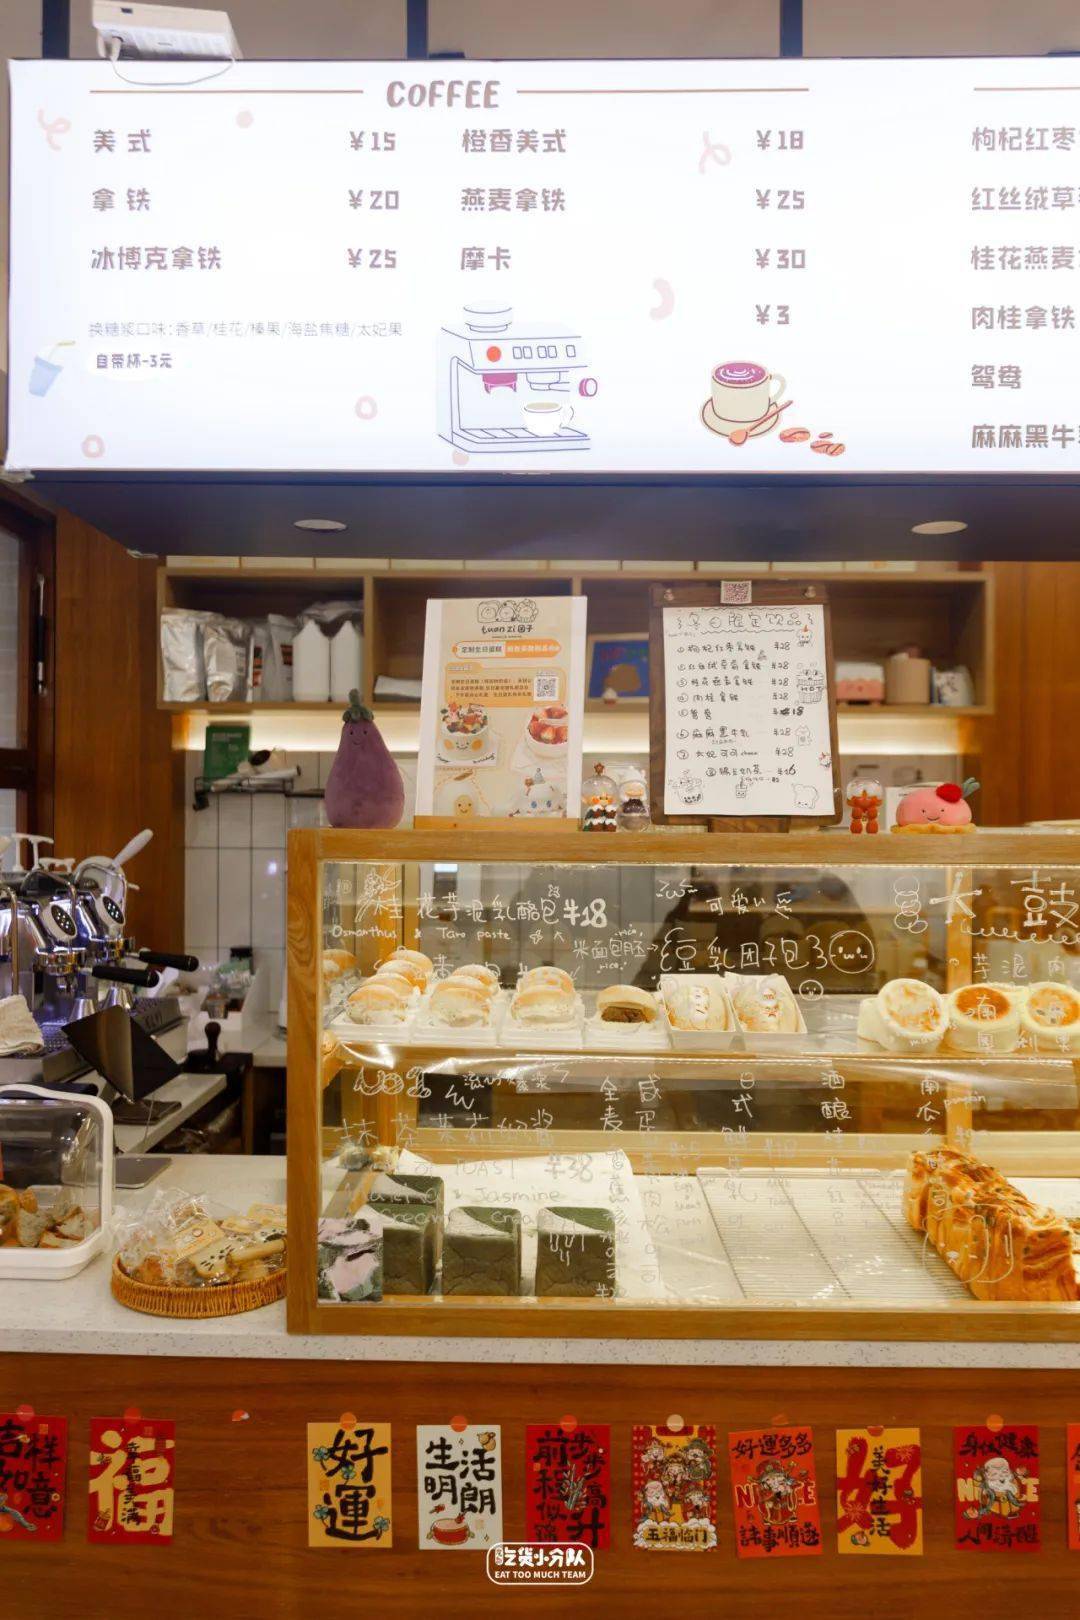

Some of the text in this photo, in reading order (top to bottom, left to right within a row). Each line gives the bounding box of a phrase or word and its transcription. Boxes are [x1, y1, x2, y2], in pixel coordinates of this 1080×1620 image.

[93, 129, 395, 153] 美式 ¥15
[462, 129, 803, 153] 橙香美式 ¥18
[972, 127, 1080, 151] 枸杞红枣
[92, 188, 399, 212] 拿铁 ¥20
[461, 188, 804, 212] 燕麦拿铁 ¥25
[972, 186, 1080, 210] 红丝绒草
[91, 246, 396, 270] 冰博克拿铁 ¥25
[461, 246, 805, 270] 摩卡 ¥30
[971, 246, 1080, 270] 桂花燕麦
[756, 304, 789, 325] ¥3
[972, 305, 1075, 329] 肉桂拿铁
[97, 353, 172, 369] 自带杯-3元
[972, 364, 1021, 389] 鸳鸯
[972, 424, 1080, 449] 麻麻黑牛
[477, 928, 511, 941] paste
[89, 1430, 175, 1537] 福
[734, 1480, 817, 1507] NE
